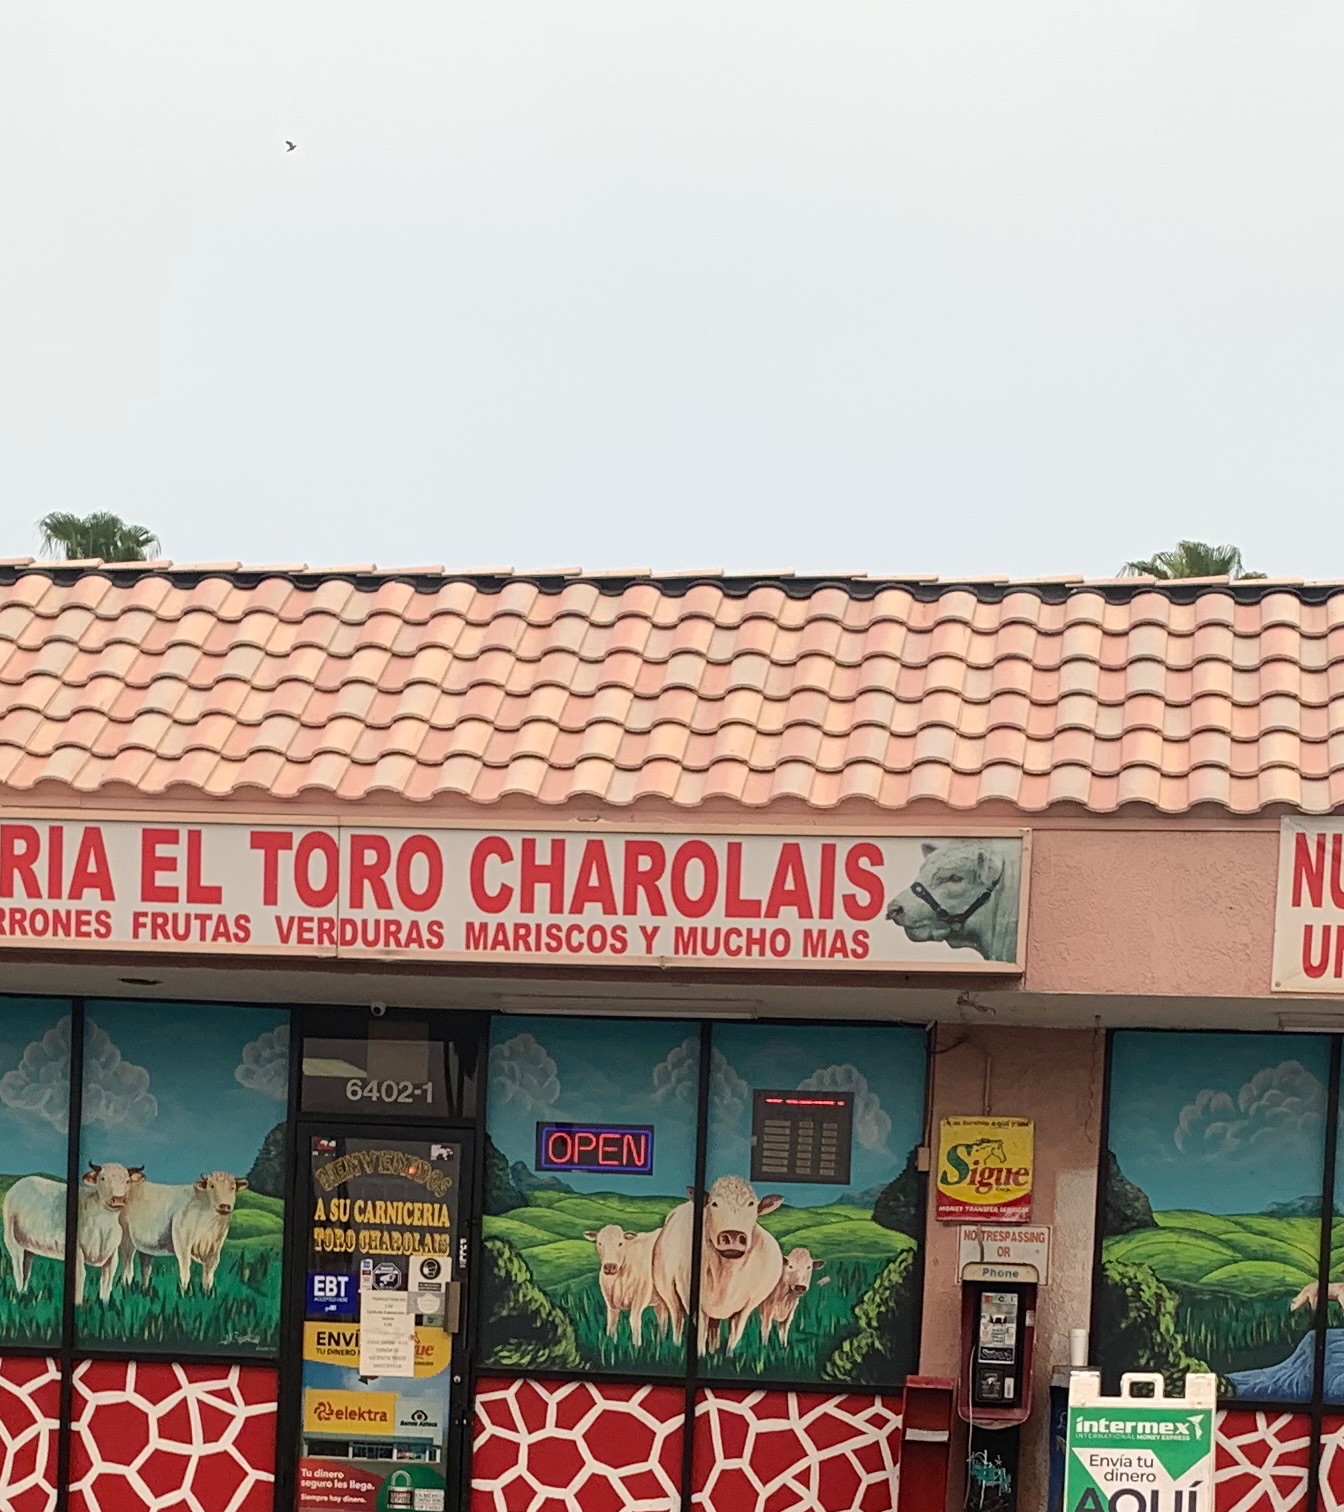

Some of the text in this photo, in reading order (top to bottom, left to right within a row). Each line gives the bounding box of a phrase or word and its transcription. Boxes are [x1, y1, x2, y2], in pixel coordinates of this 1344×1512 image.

[140, 828, 223, 905] EL
[250, 830, 443, 911] TORO
[469, 835, 886, 922] CHAROLAIS
[132, 911, 251, 944] FRUTAS
[275, 915, 445, 949] VERDURAS
[465, 921, 628, 954] MARISCOS
[638, 925, 659, 955] Y
[673, 926, 792, 957] MUCHO
[802, 928, 870, 959] MAS
[346, 1079, 433, 1104] 6402-1
[548, 1132, 646, 1167] OPEN
[939, 1143, 1030, 1194] Sigue
[314, 1198, 451, 1228] A SU CARNICERIA
[313, 1227, 450, 1257] TORO CHAROLAIS
[963, 1230, 1045, 1243] NO TRESPASSING
[997, 1246, 1011, 1257] OR
[982, 1267, 1019, 1279] Phone
[314, 1275, 349, 1297] EBT
[335, 1406, 388, 1422] elektra
[1089, 1453, 1154, 1468] Envía tu
[301, 1468, 344, 1479] Tu dinero
[1103, 1468, 1157, 1483] dinero
[300, 1480, 333, 1490] seguro
[334, 1480, 348, 1489] les
